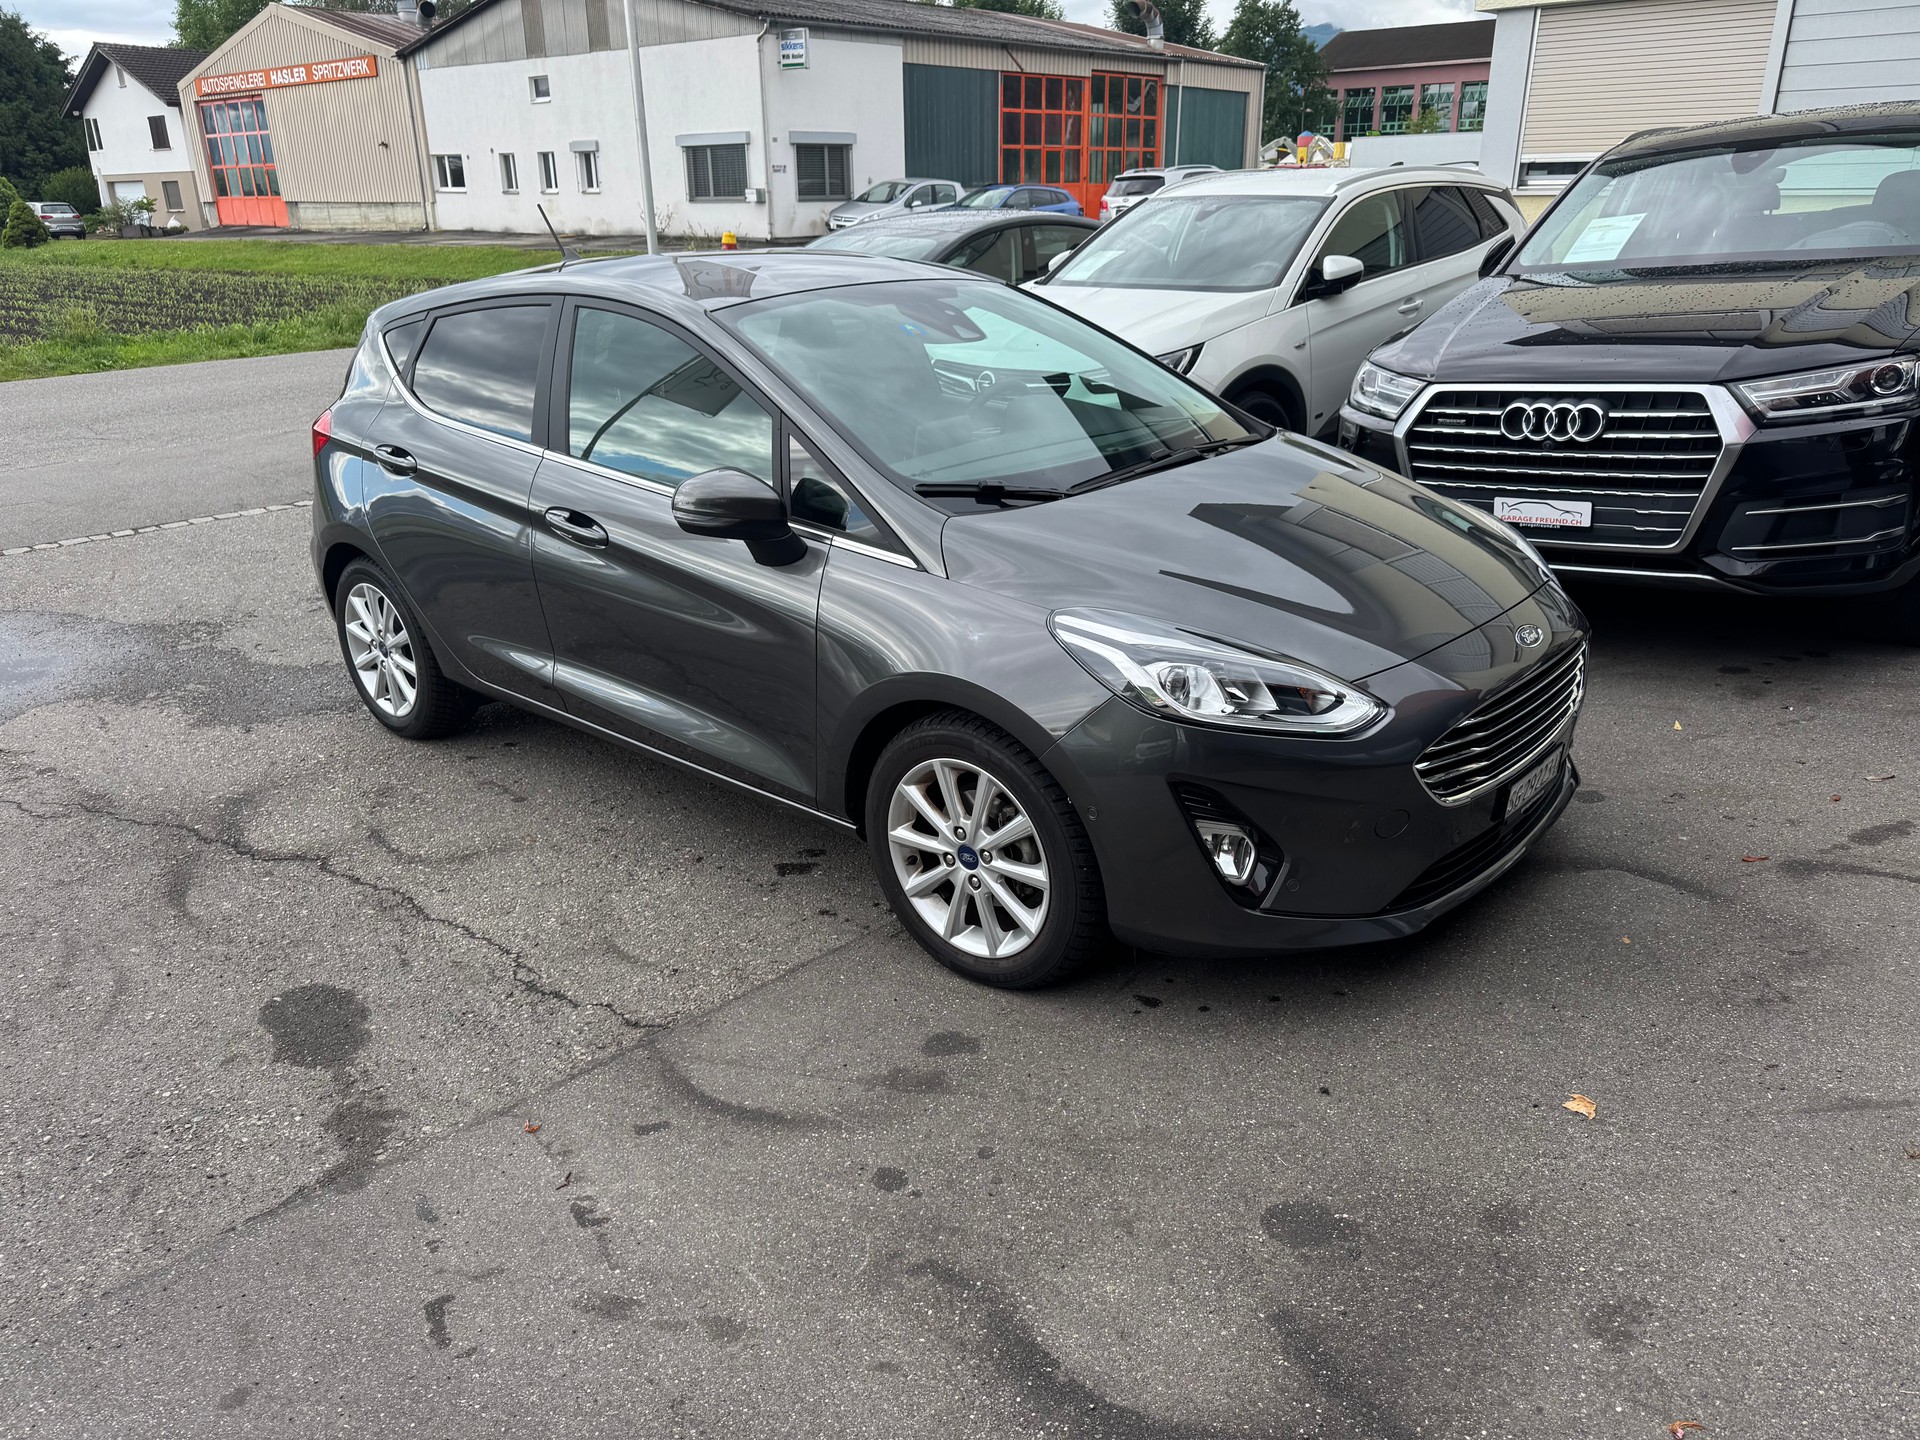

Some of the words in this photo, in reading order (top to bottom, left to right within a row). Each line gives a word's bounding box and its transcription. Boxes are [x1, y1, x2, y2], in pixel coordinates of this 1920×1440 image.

[201, 72, 266, 94] AUTOSPENGLEREI
[270, 67, 306, 86] HASLER
[311, 58, 370, 81] SPRITZWERK
[1501, 515, 1533, 523] GARAGE
[1535, 517, 1582, 525] FREUND.CH
